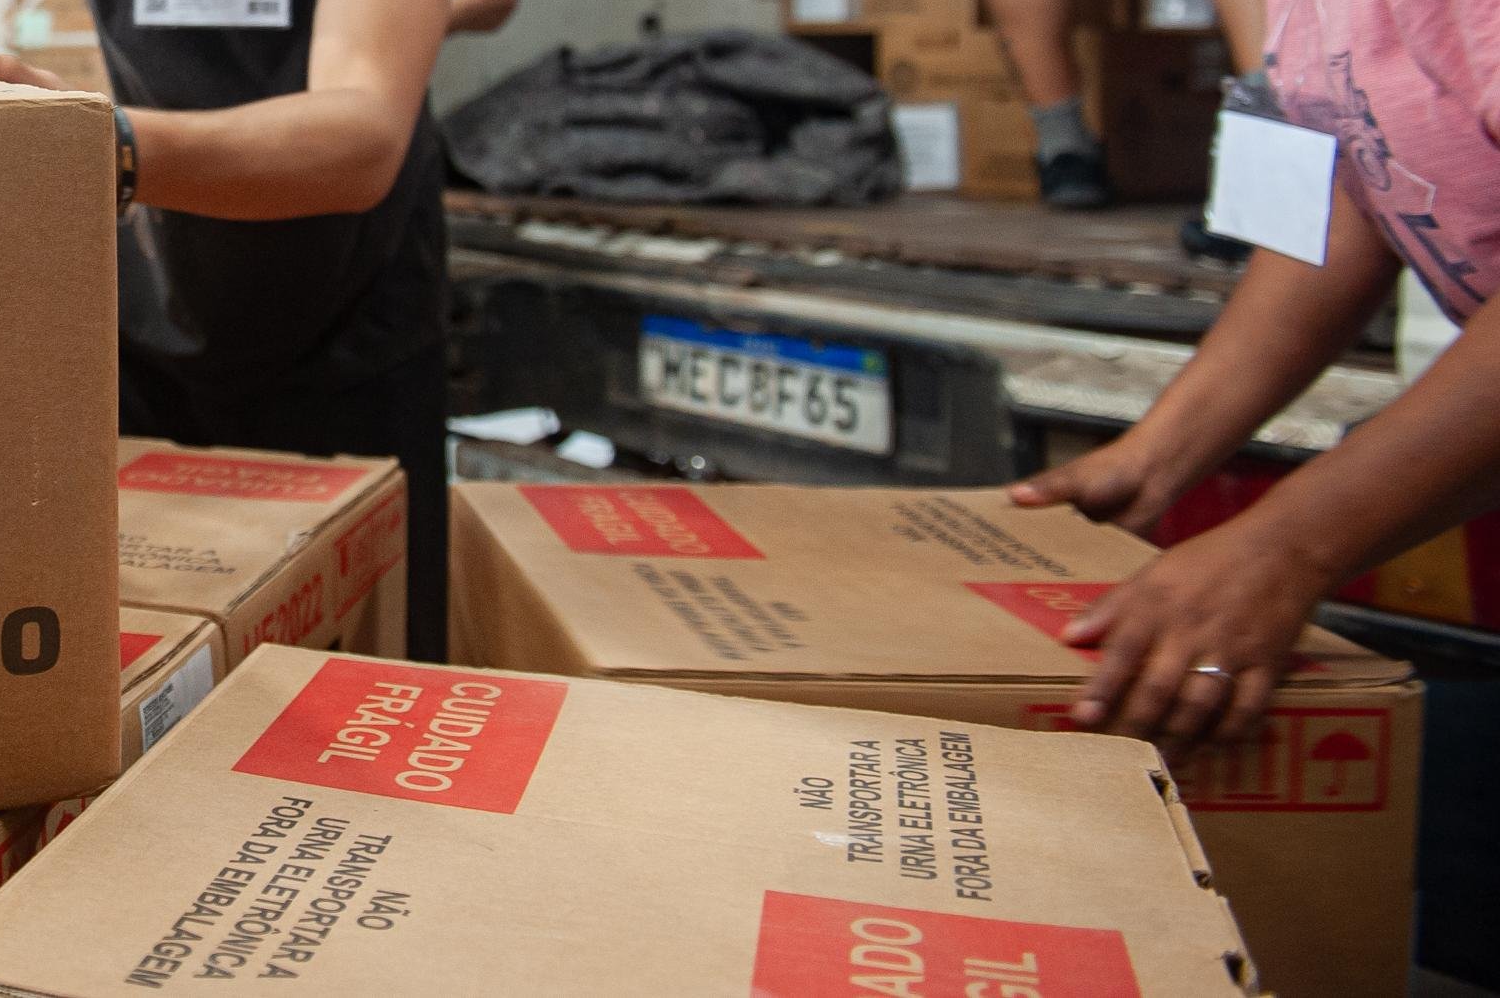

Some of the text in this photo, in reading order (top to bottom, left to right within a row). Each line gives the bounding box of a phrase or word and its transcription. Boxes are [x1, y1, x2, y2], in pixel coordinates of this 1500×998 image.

[317, 682, 424, 763] FRÁGIL
[394, 682, 502, 792] CUIDADO
[794, 777, 834, 810] NÃO
[847, 740, 884, 863] TRANSPORTAR A
[888, 738, 938, 880] URNA ELETRÔNICA
[939, 731, 993, 902] FORA DA EMBALAGEM
[123, 796, 314, 990] FORA DA EMBALAGEM
[193, 817, 351, 980] URNA ELETRÔNICA
[256, 834, 393, 979] TRANSPORTAR A
[356, 889, 412, 931] NÃO
